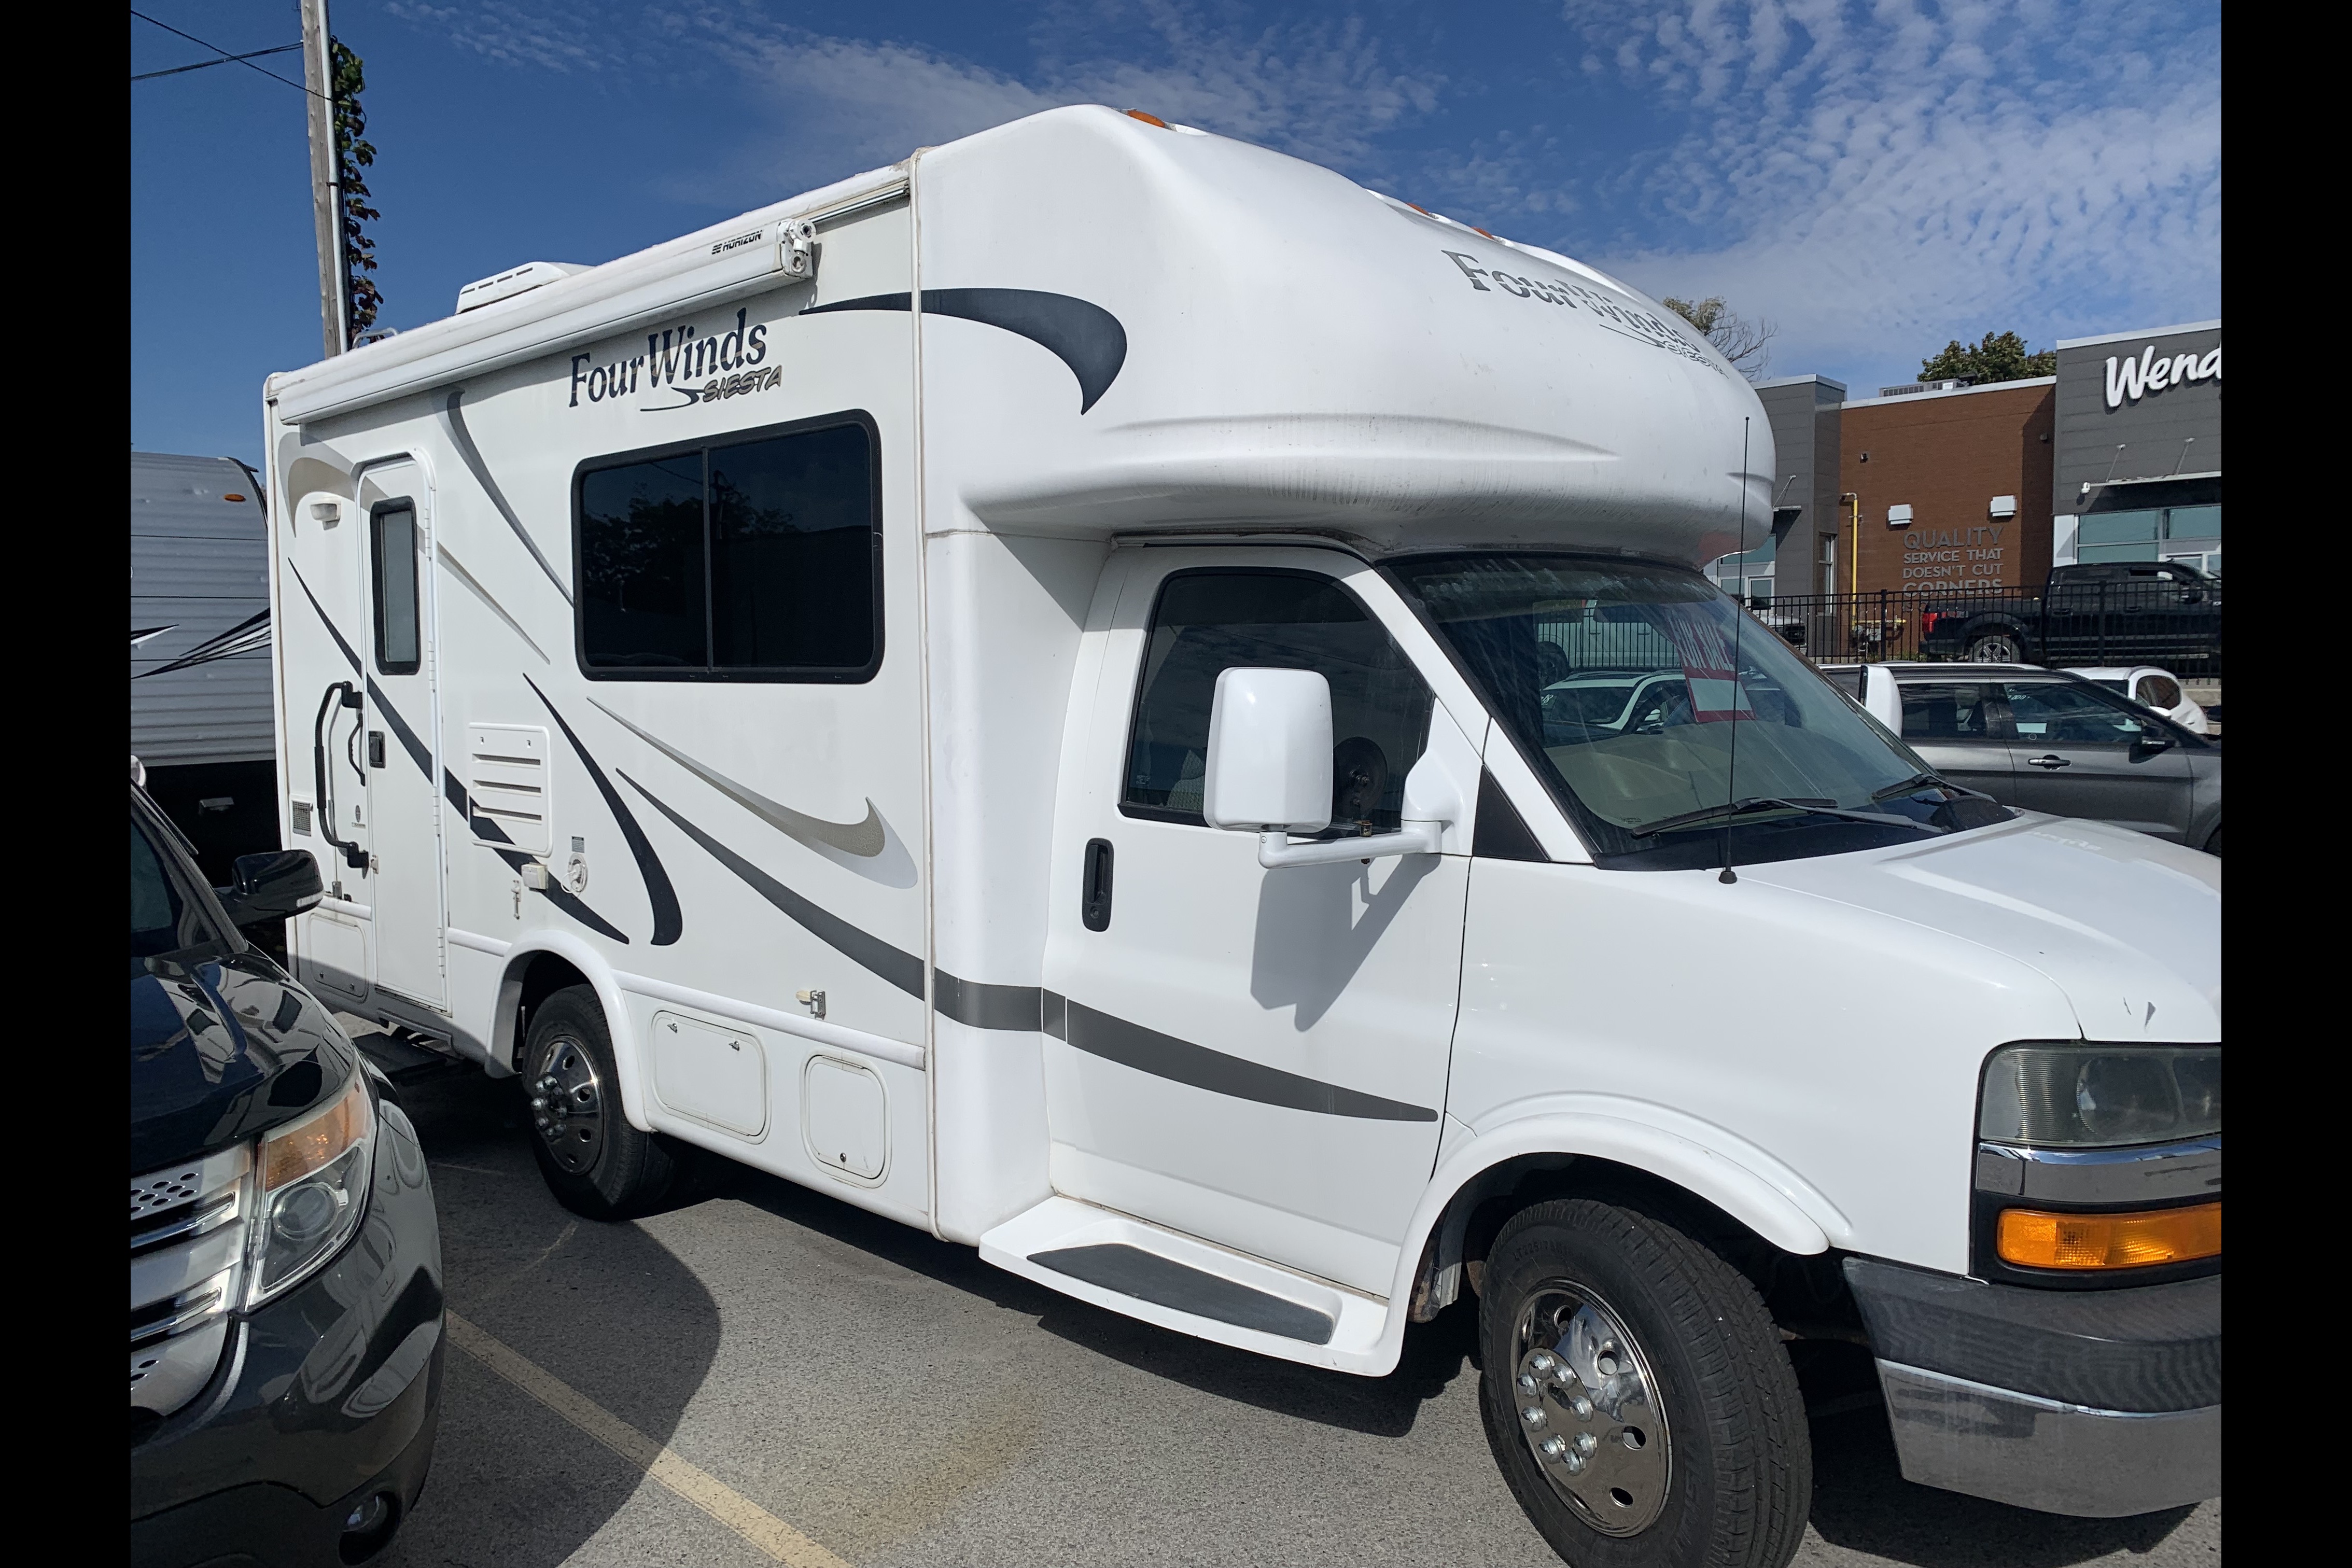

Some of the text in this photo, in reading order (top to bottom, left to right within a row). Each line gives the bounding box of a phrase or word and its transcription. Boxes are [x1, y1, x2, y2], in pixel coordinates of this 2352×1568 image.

[702, 365, 782, 403] SIESTA
[1903, 526, 2004, 550] QUALITY
[1903, 548, 2004, 564] SERVICE THAT
[1902, 563, 2004, 579] DOESN'T CUT
[1902, 579, 2003, 597] CORNERS
[1663, 607, 1735, 671] FOR SALE
